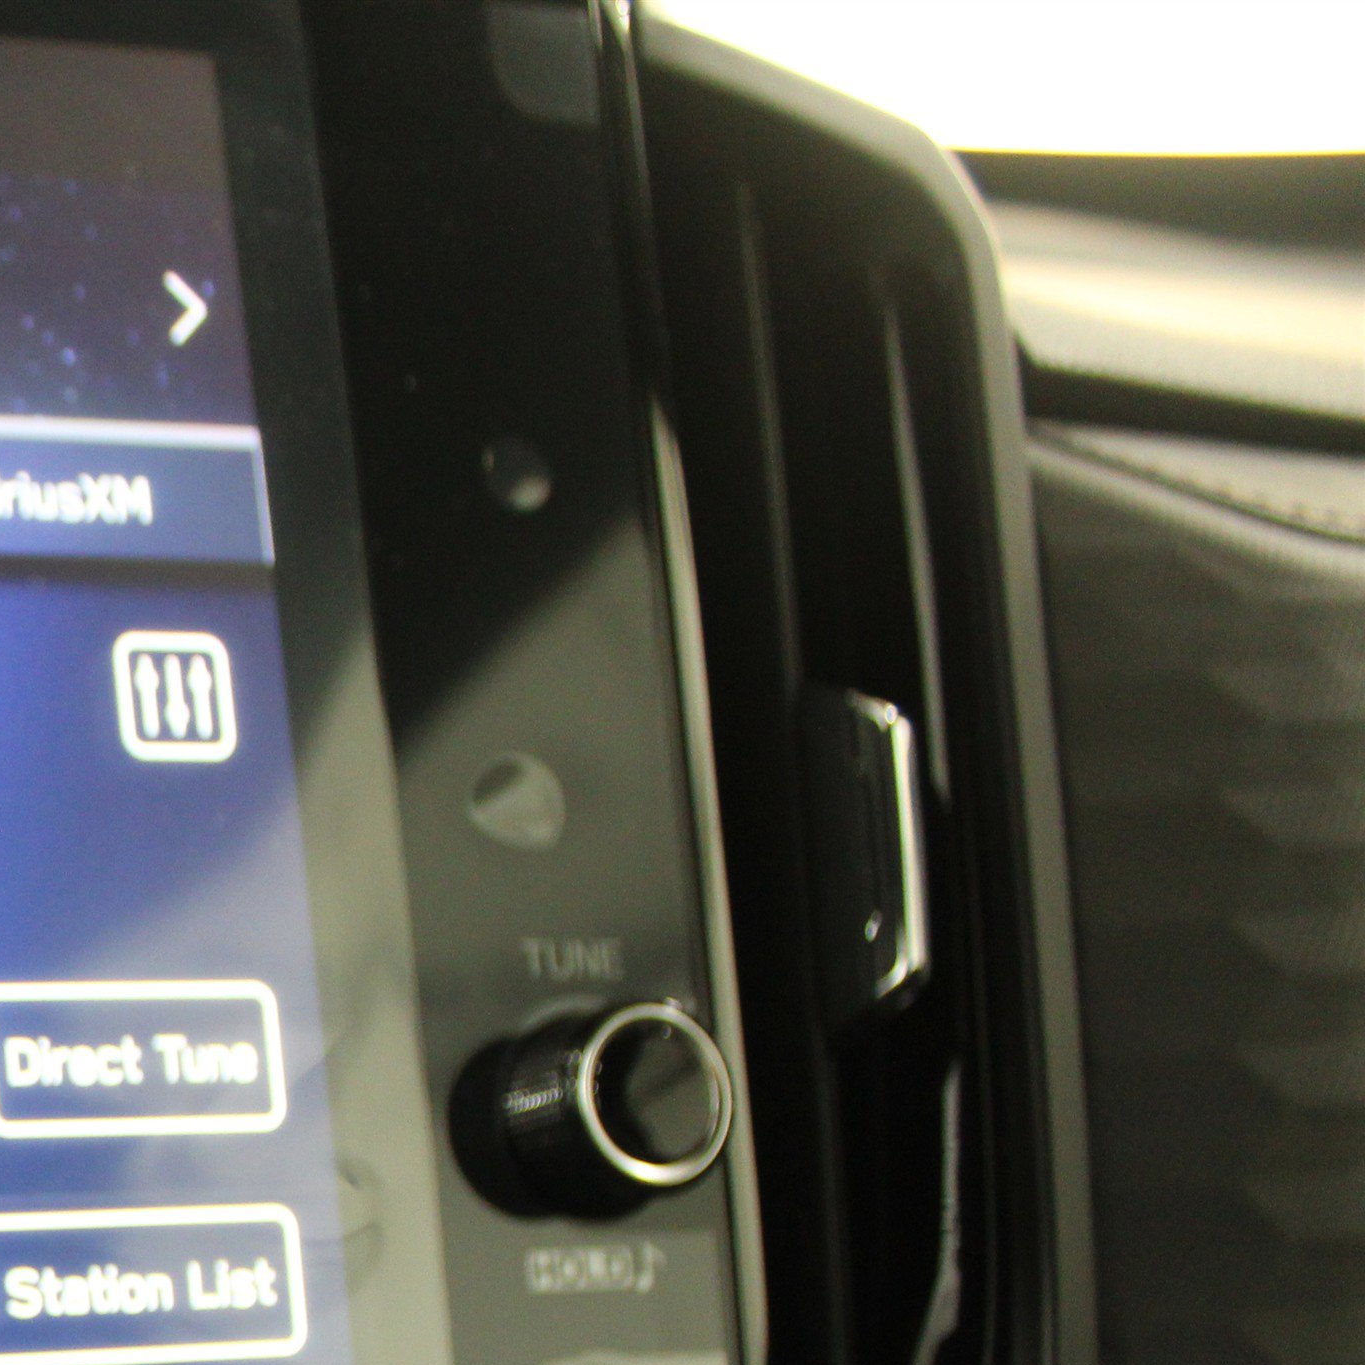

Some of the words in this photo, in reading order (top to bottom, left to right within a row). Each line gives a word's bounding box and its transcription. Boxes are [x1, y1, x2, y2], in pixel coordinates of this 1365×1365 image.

[523, 937, 623, 981] TUNE
[5, 1034, 142, 1088] Direct
[153, 1034, 259, 1084] Tune
[4, 1265, 174, 1320] Station
[186, 1258, 278, 1310] List
